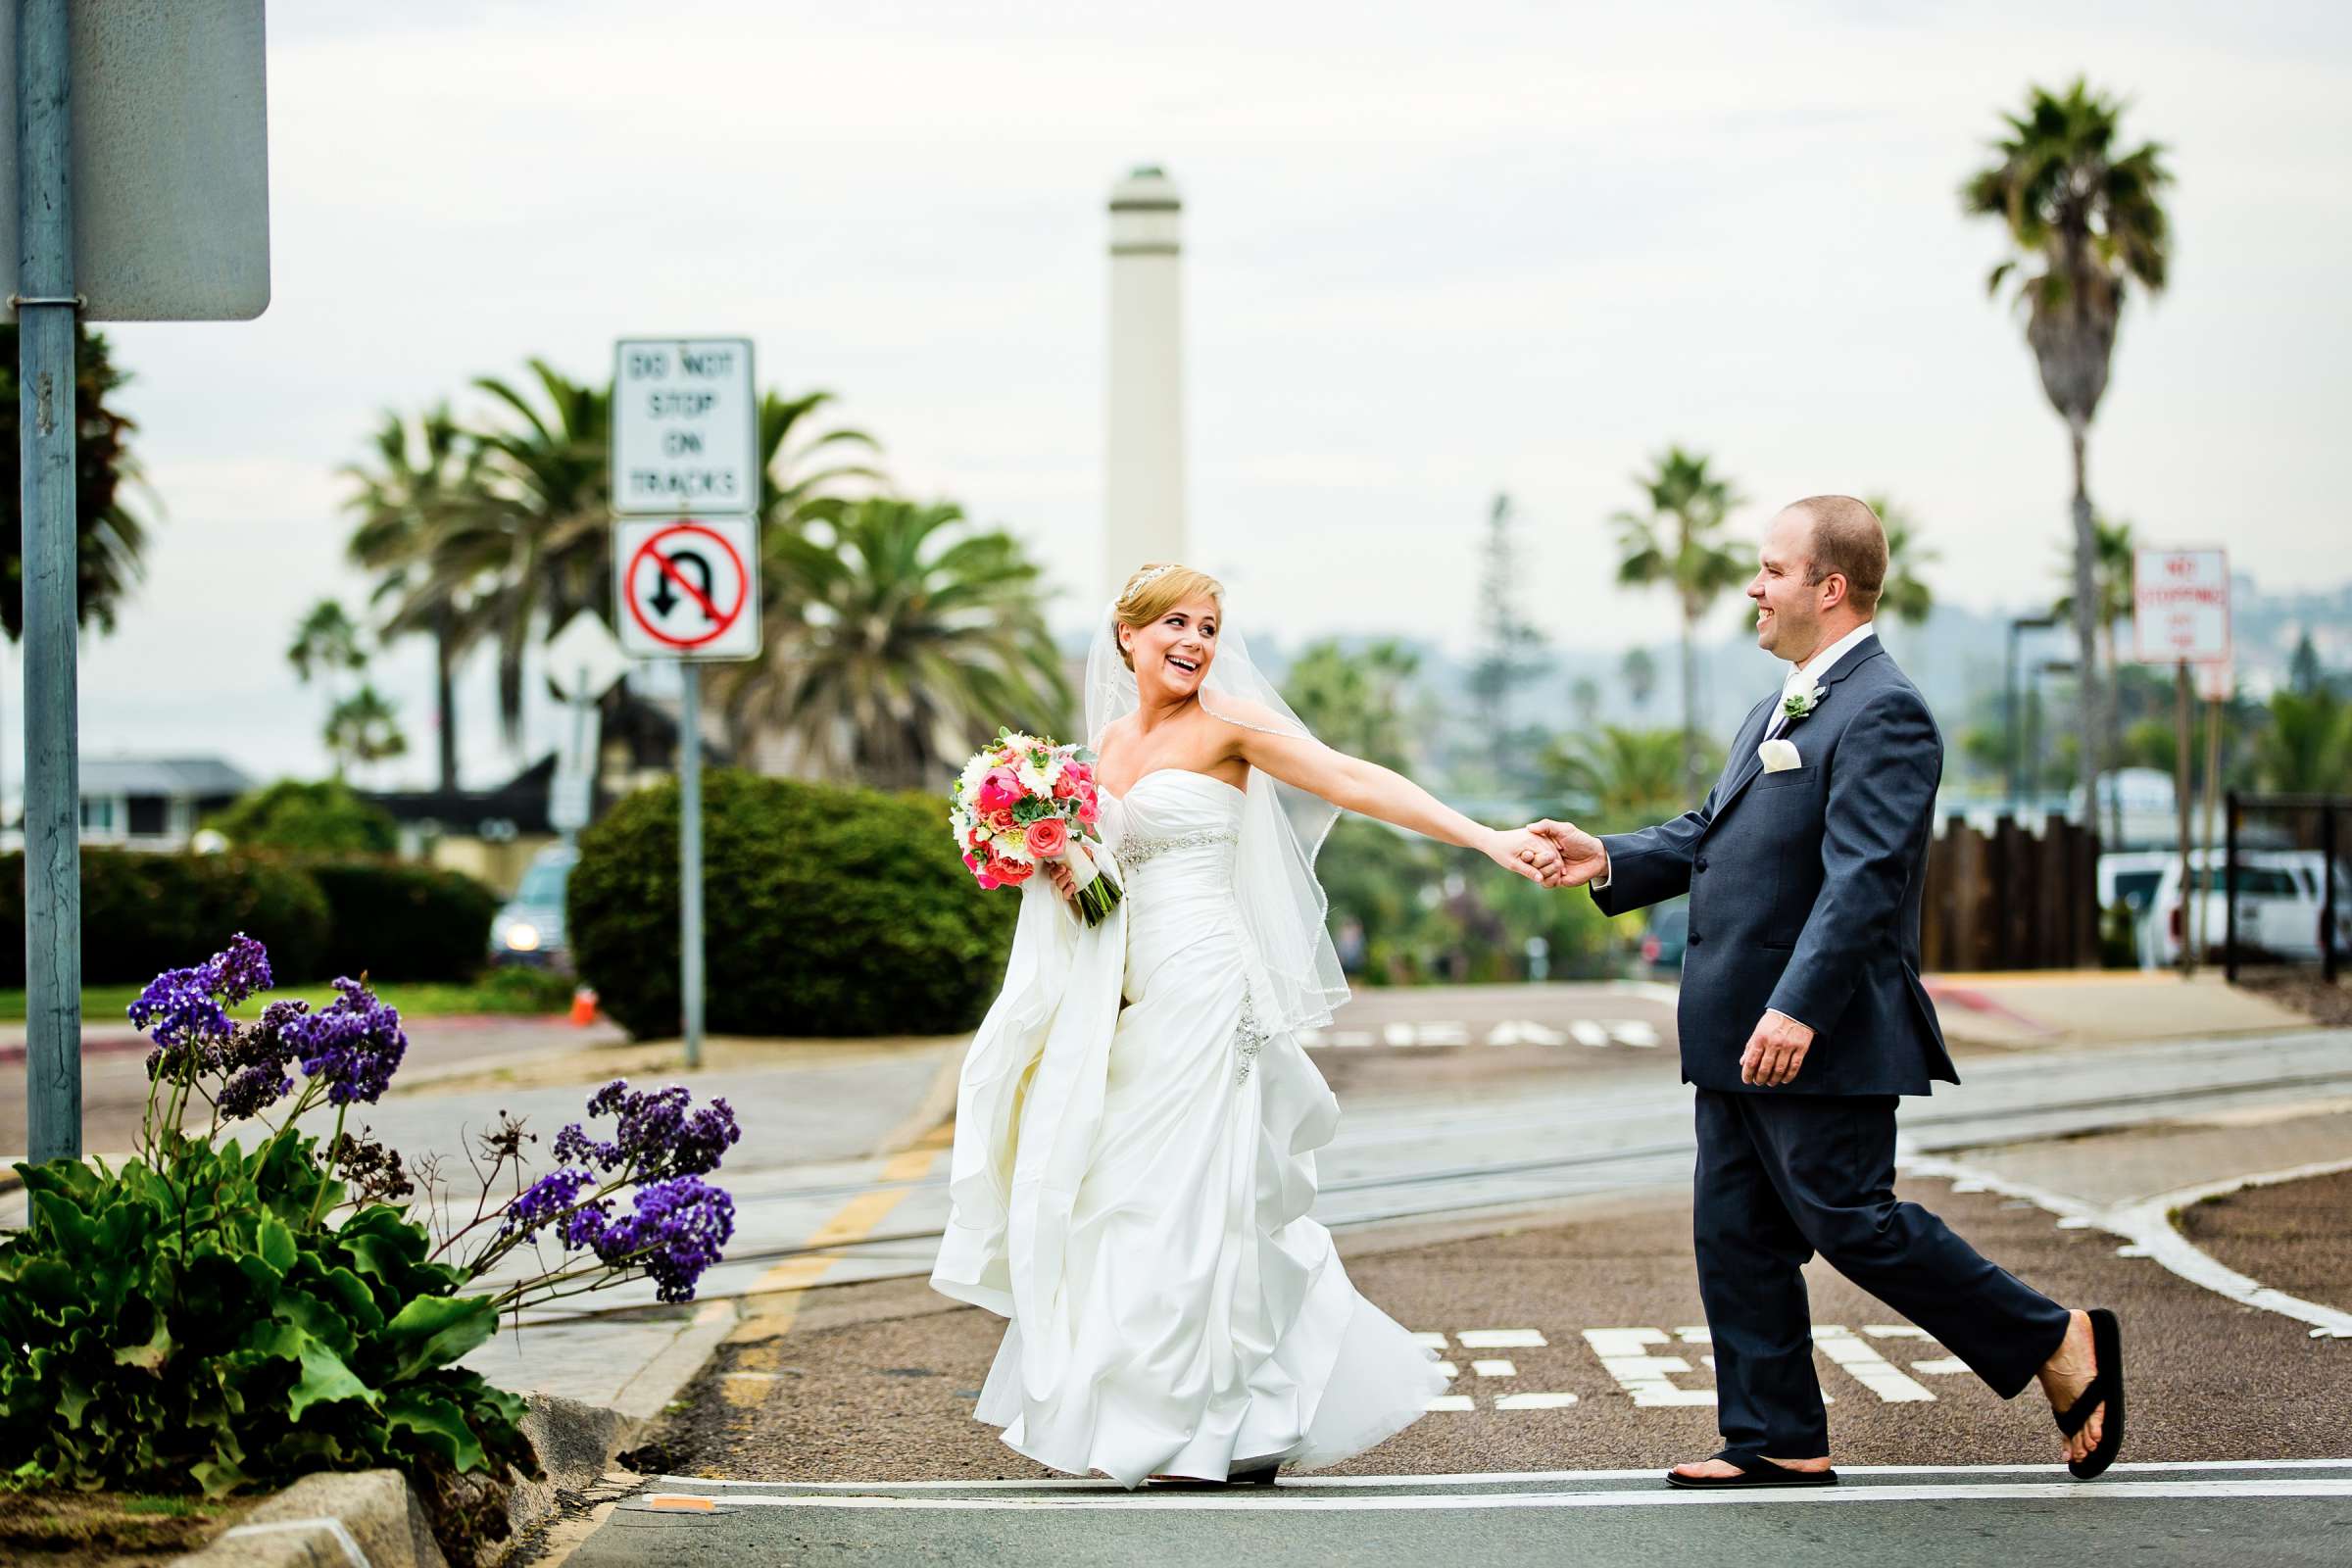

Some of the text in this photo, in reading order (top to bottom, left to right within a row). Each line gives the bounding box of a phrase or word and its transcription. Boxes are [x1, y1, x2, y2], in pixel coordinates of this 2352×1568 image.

[630, 352, 734, 378] DO NOT
[650, 391, 715, 418] STOP
[664, 431, 703, 458] ON
[630, 469, 737, 495] TRACKS
